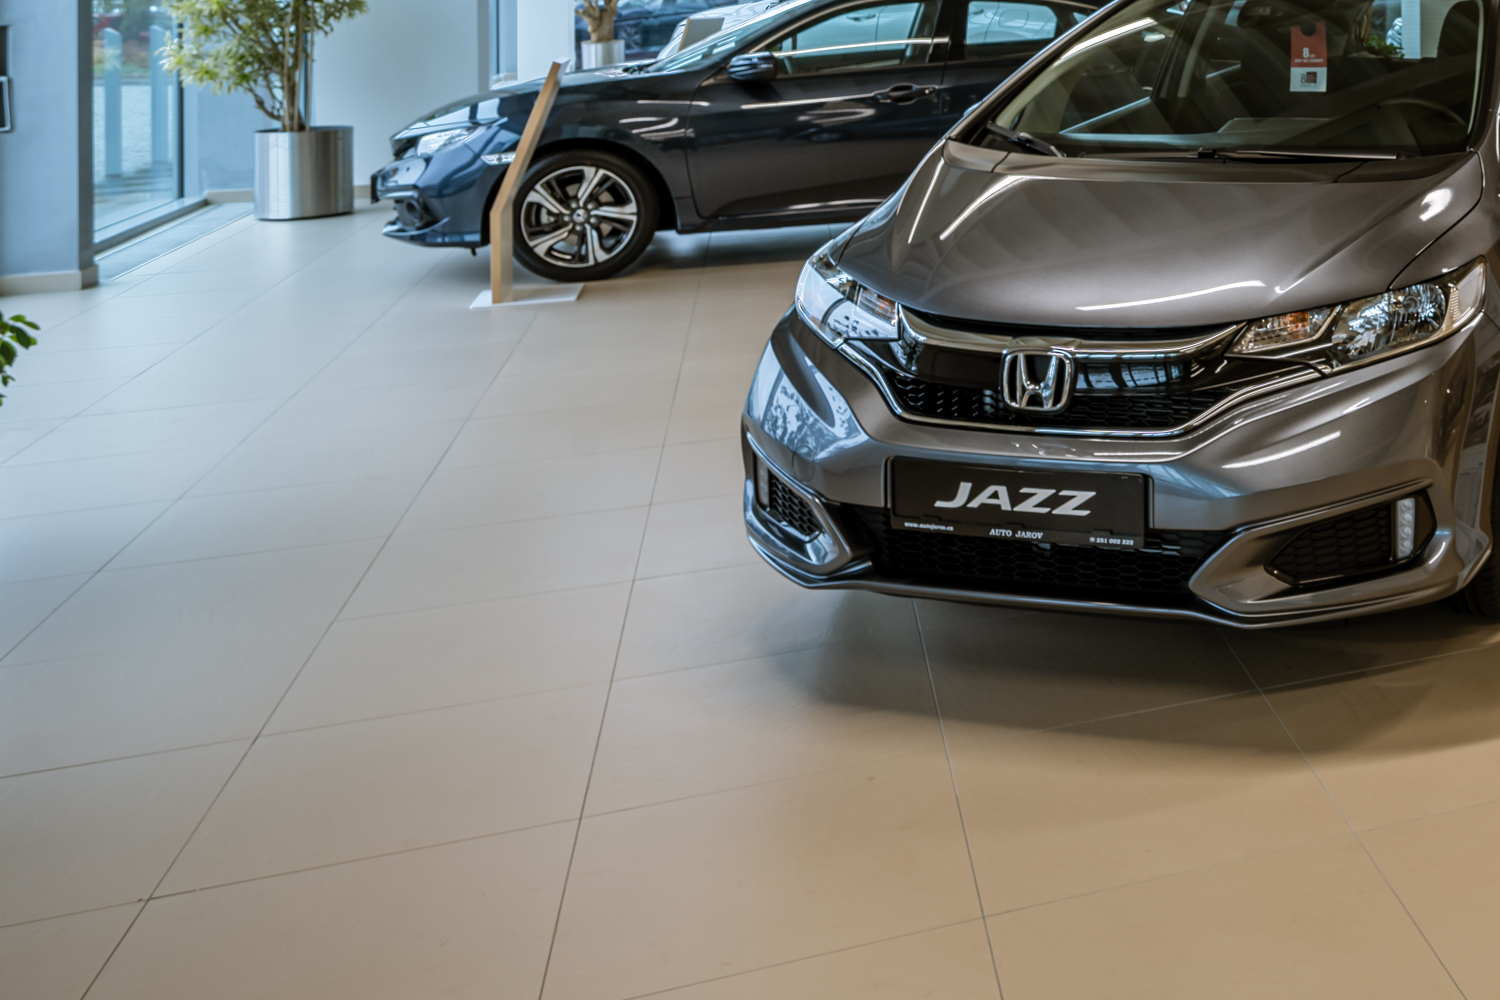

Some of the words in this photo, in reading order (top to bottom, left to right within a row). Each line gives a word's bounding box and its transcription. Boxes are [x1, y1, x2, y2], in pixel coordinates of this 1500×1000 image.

[934, 481, 1097, 517] JAZZ
[989, 528, 1013, 538] AUTO
[1015, 530, 1044, 540] JAROV
